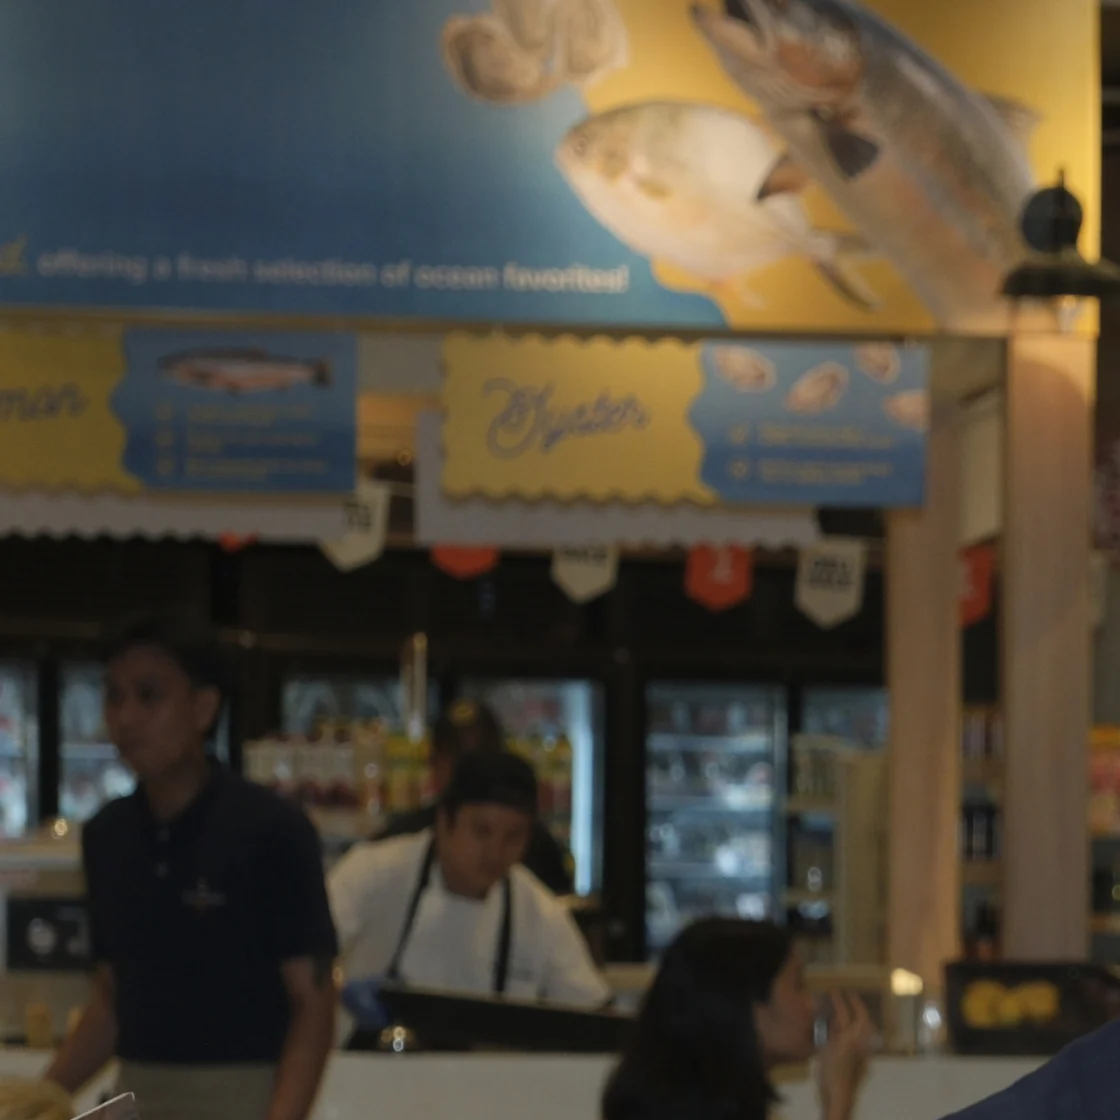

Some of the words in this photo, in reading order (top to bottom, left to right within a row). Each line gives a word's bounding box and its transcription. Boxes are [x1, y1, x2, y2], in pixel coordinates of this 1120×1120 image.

[37, 249, 147, 284] offering
[152, 255, 171, 280] a
[178, 251, 247, 283] fresh
[254, 255, 376, 287] selection
[380, 259, 412, 288] of
[415, 265, 498, 290] ocean
[504, 261, 629, 293] favorites!
[482, 377, 651, 461] Oyster
